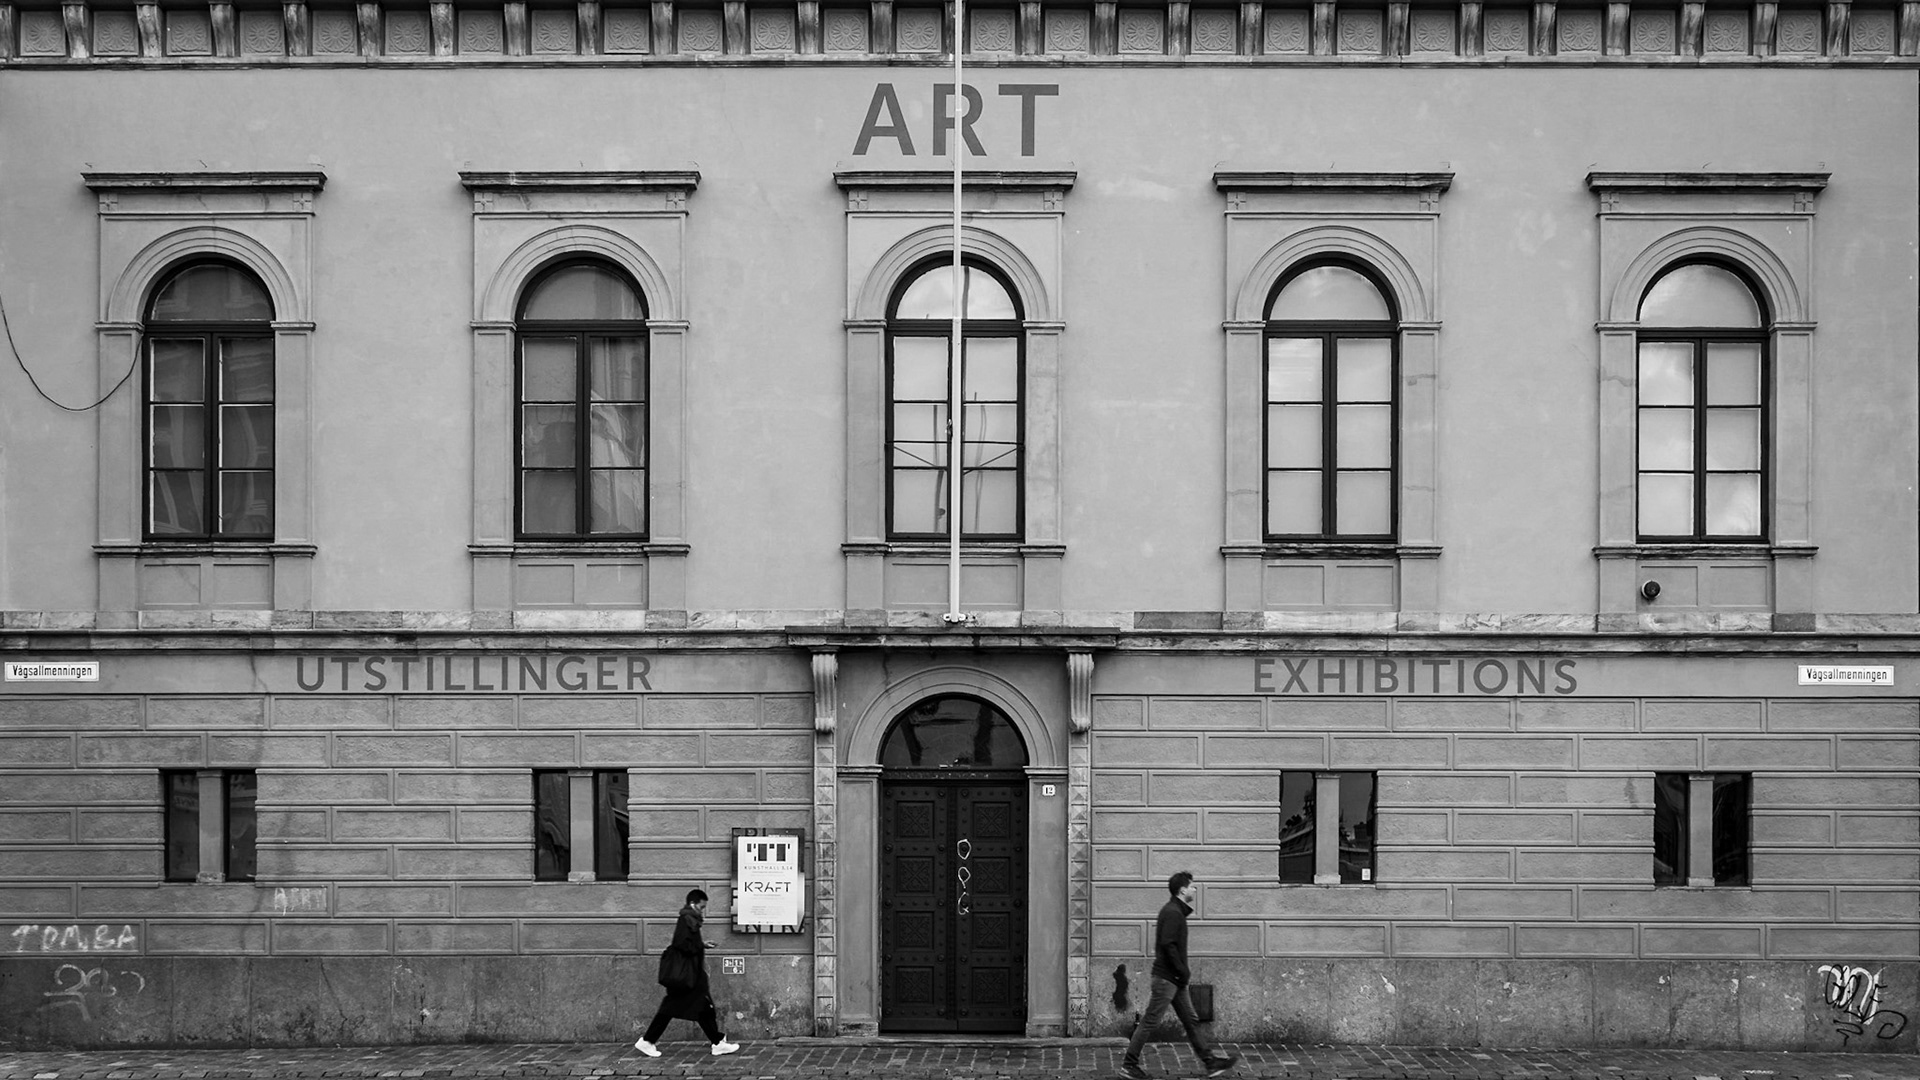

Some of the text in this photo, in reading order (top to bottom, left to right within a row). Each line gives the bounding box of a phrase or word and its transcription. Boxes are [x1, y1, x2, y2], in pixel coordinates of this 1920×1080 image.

[852, 83, 1059, 157] ART
[296, 656, 653, 692] UTSTILLINGER
[1254, 658, 1578, 694] EXHIBITIONS
[744, 881, 792, 893] KRAFT
